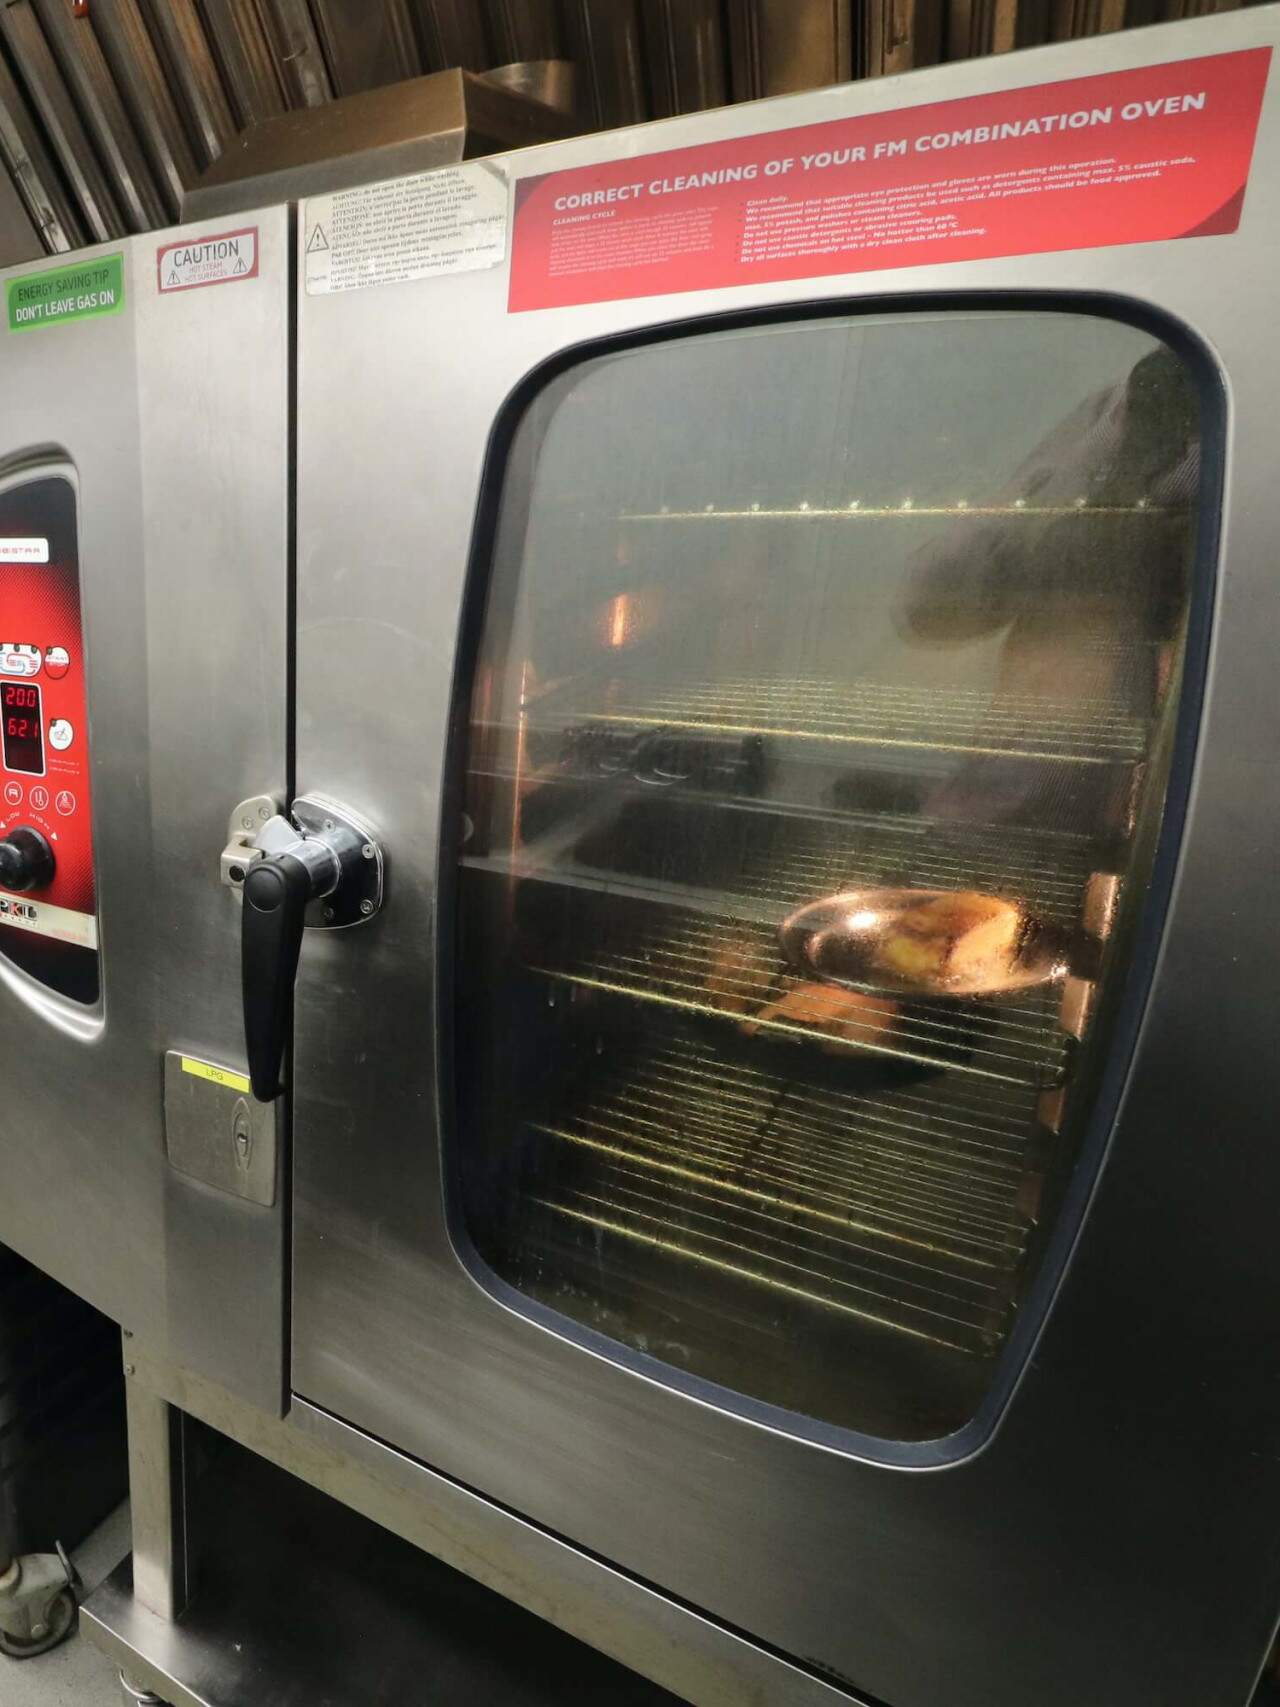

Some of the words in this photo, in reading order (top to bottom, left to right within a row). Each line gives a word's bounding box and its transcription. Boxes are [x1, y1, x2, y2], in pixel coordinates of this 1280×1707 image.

[554, 183, 643, 210] CORRECT
[648, 164, 757, 195] CLEANING
[763, 157, 797, 176] OF
[799, 145, 867, 170] YOUR
[873, 139, 908, 158] FM
[914, 105, 1113, 153] COMBINATION
[1119, 90, 1206, 122] OVEN
[759, 209, 802, 220] recommend
[822, 202, 852, 211] suitable
[854, 197, 886, 208] cleaning
[888, 192, 923, 204] products
[1133, 158, 1169, 169] caustic
[759, 200, 803, 212] recommend
[823, 191, 869, 204] appropriate
[886, 182, 929, 196] protection
[820, 211, 851, 221] polishes
[852, 205, 894, 217] containing
[1002, 185, 1041, 197] products
[552, 213, 590, 226] CLEANING
[591, 209, 615, 219] CYCLE
[783, 224, 815, 234] pressure
[783, 233, 808, 241] caustic
[809, 227, 851, 239] detergents
[174, 239, 239, 267] CAUTION
[17, 281, 52, 302] ENERGY
[55, 272, 91, 293] SAVING
[93, 267, 109, 284] TIP
[15, 303, 42, 322] DON'T
[44, 296, 74, 316] LEAVE
[77, 291, 97, 310] GAS
[99, 288, 114, 305] ON
[6, 687, 36, 707] 200
[206, 1070, 223, 1080] LPG
